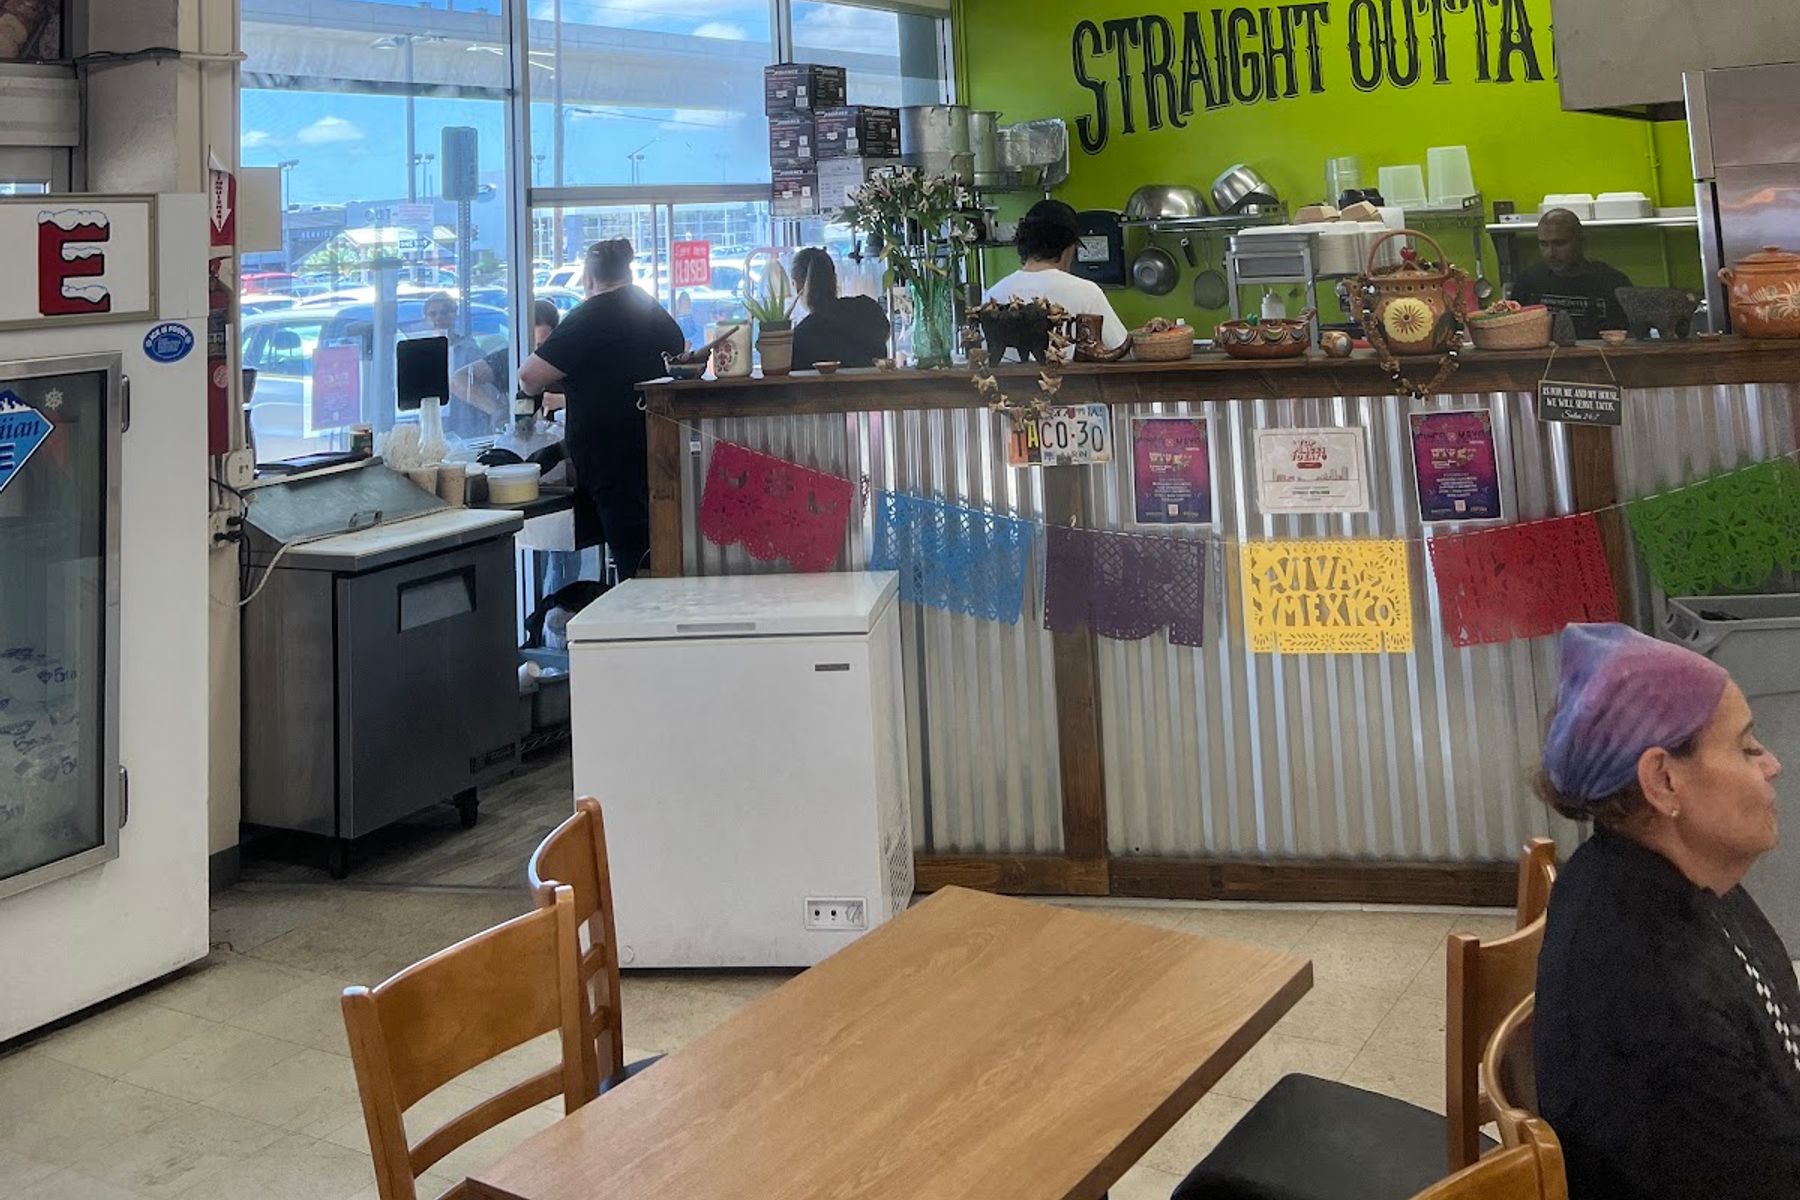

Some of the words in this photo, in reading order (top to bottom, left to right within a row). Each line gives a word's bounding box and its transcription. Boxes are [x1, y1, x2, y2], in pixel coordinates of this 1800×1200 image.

[1072, 2, 1330, 155] STRAIGHT
[38, 209, 111, 316] E
[1272, 556, 1355, 592] VIVA
[1273, 593, 1395, 627] MEXICO
